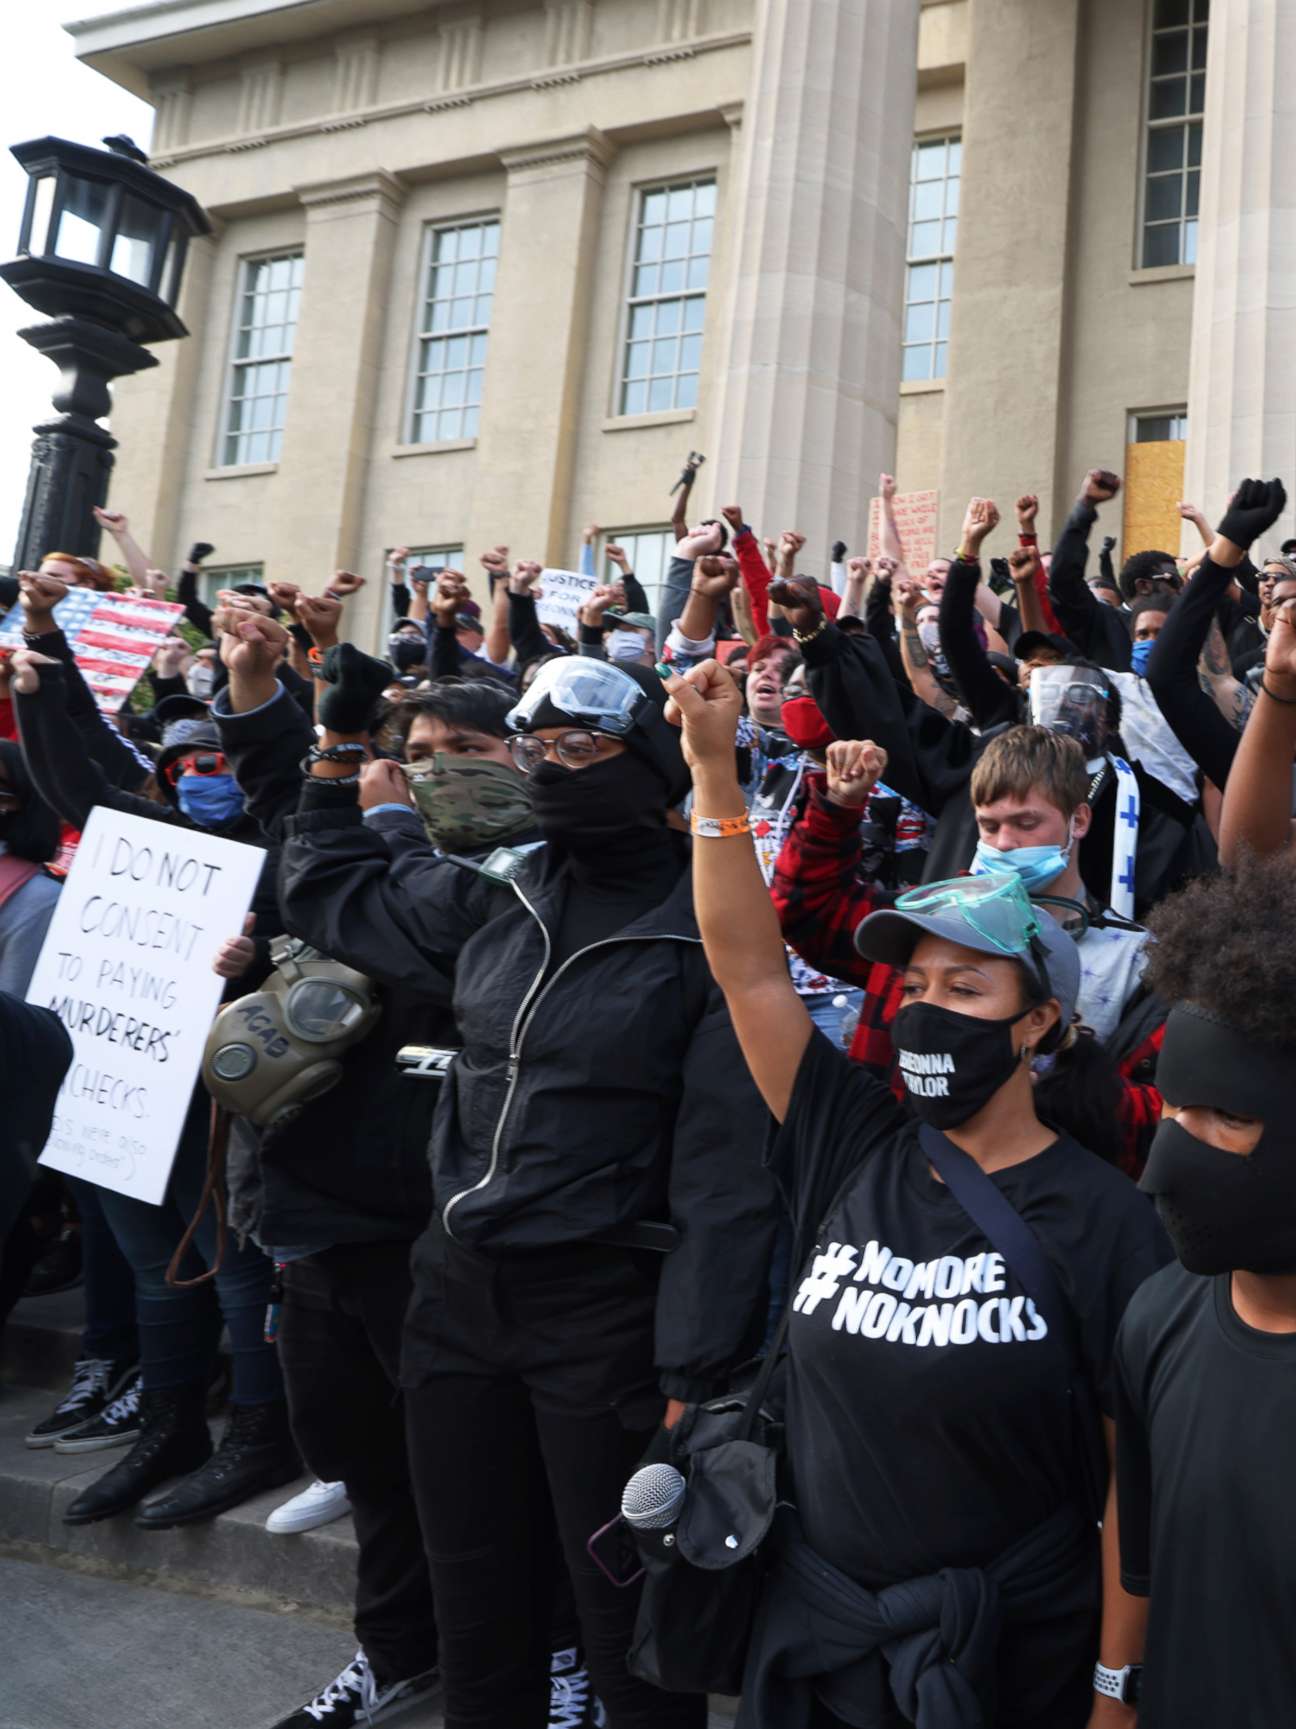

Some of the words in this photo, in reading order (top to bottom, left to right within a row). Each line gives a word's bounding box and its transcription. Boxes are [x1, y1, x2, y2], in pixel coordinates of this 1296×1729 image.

[550, 590, 582, 602] FOR
[92, 834, 104, 868] I
[110, 837, 153, 882] DO
[156, 852, 223, 897] NOT
[80, 896, 205, 962] CONSENT
[58, 952, 83, 982] TO
[96, 959, 178, 1010] PAYING
[238, 1005, 290, 1058] ACAB
[811, 1240, 1006, 1300] #NOMORE
[793, 1276, 1048, 1347] #NOKNOCKS
